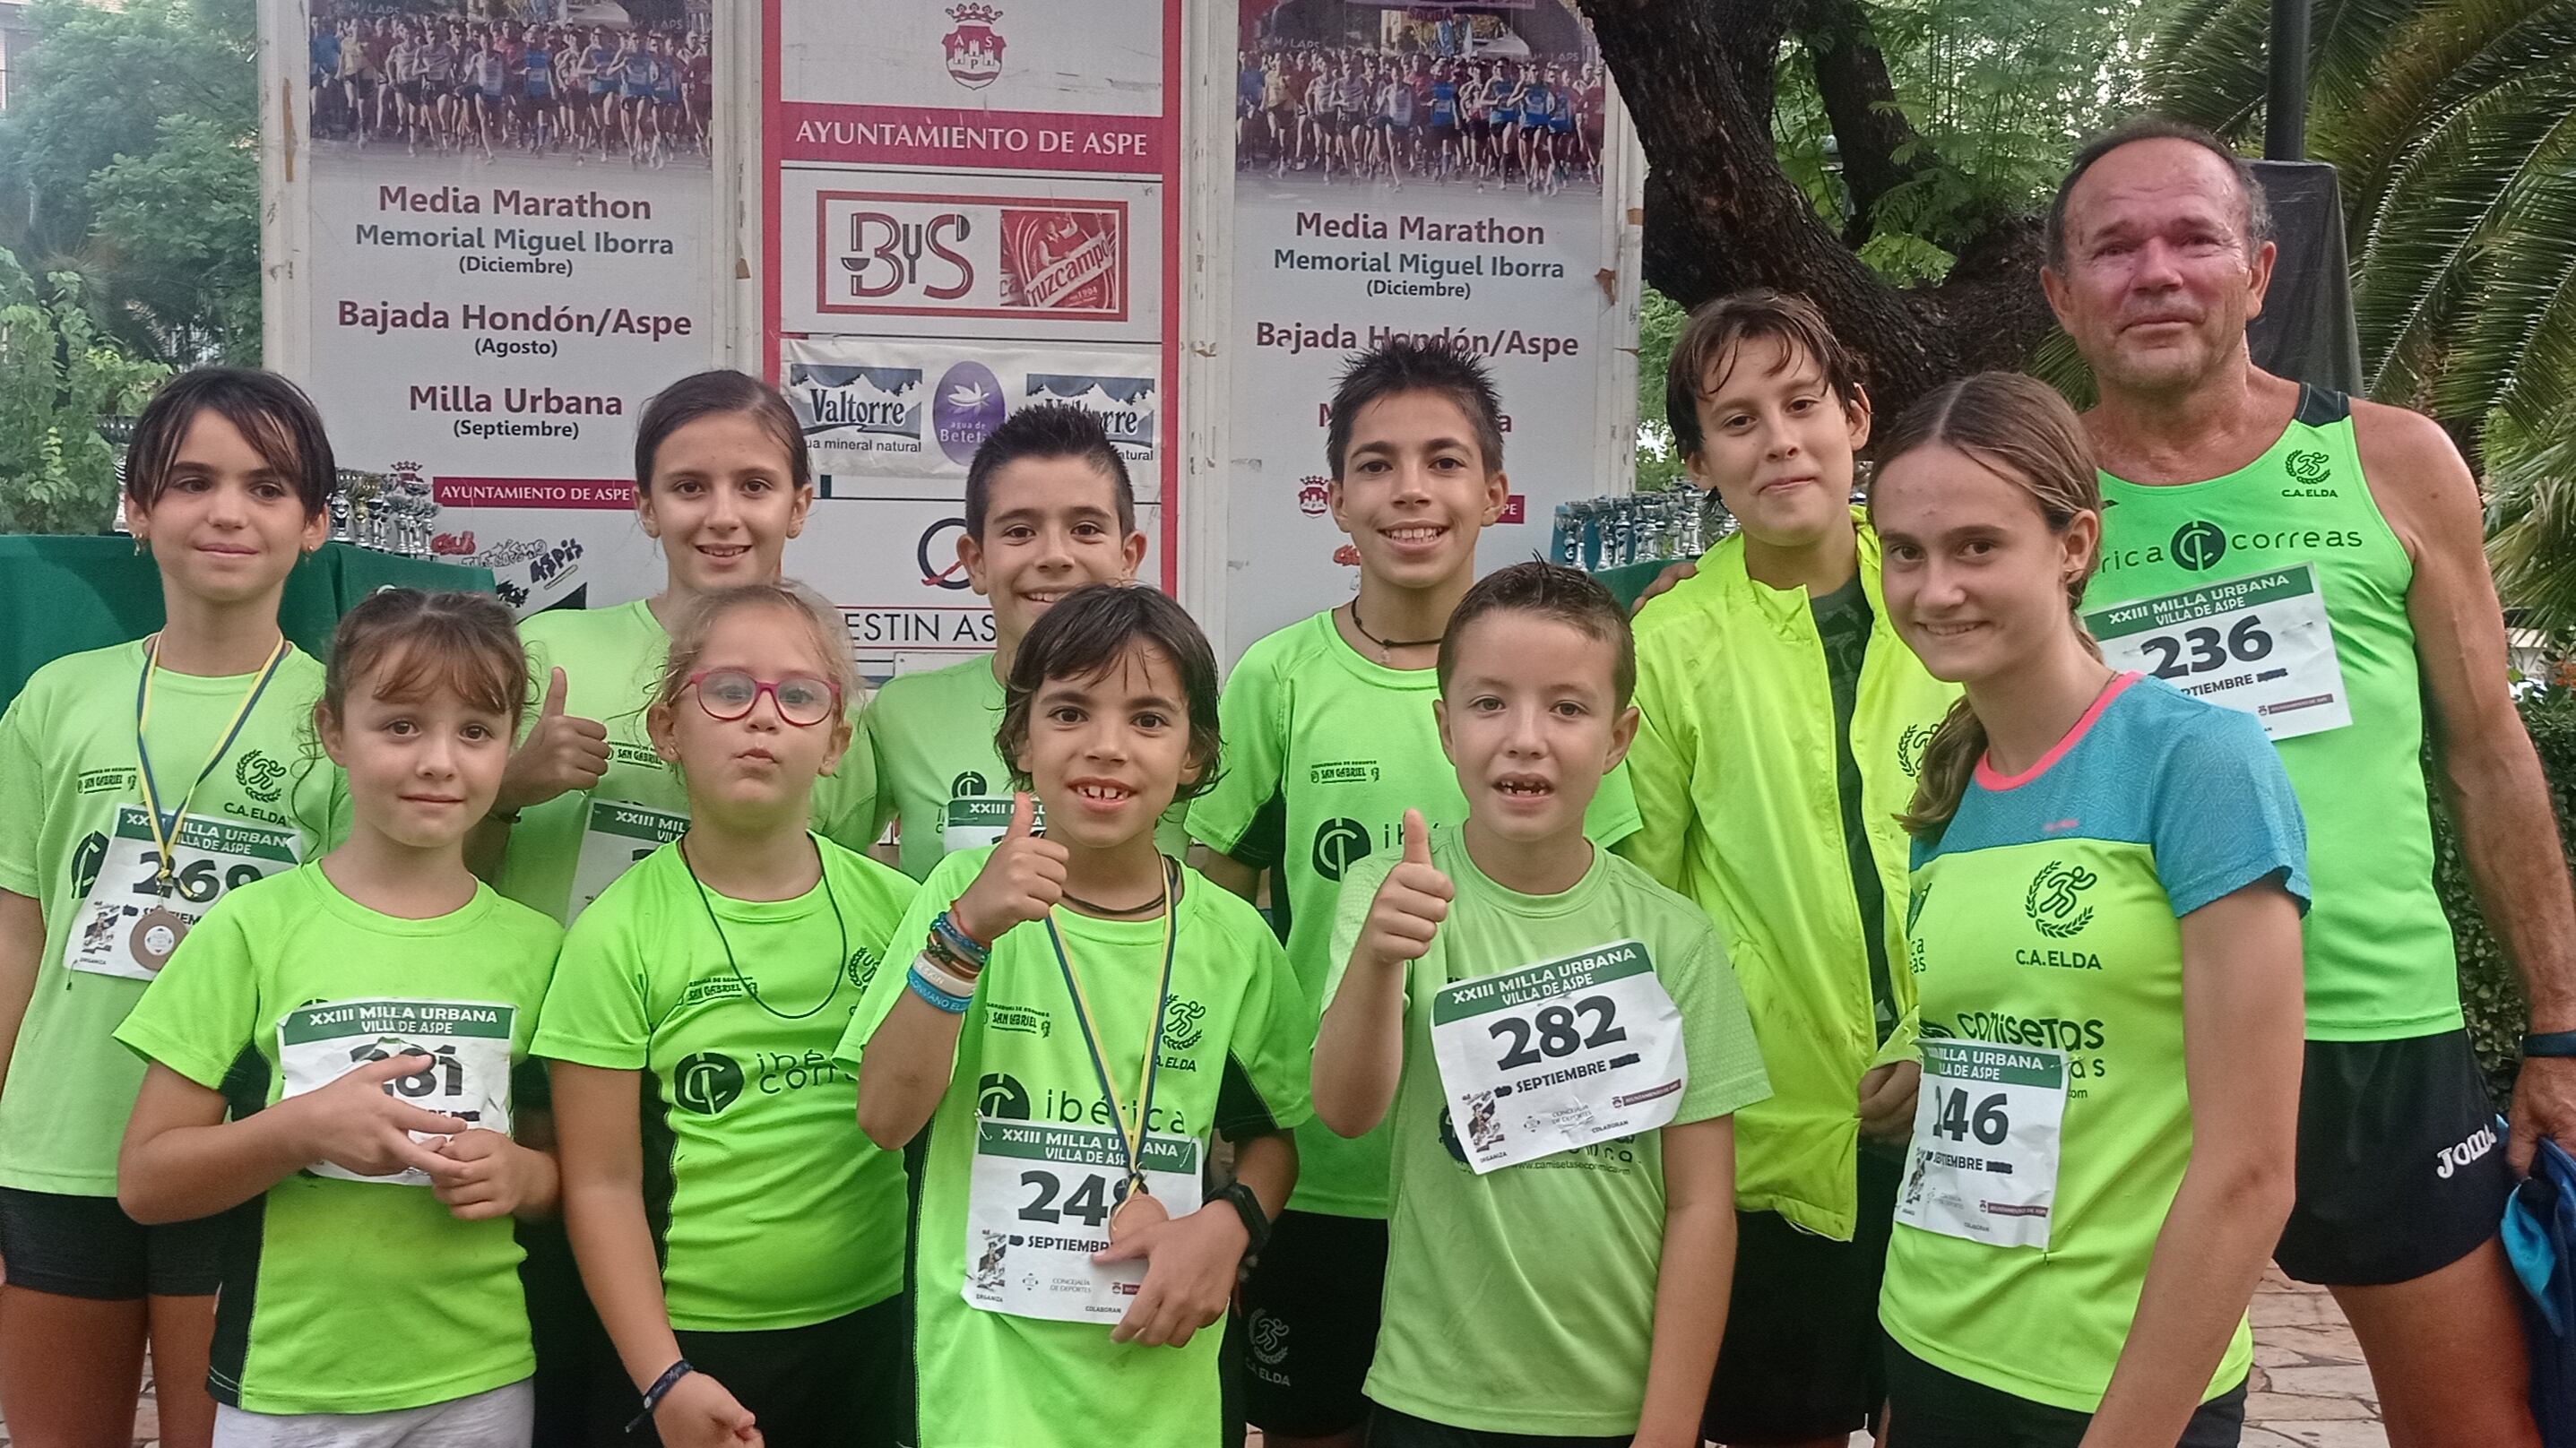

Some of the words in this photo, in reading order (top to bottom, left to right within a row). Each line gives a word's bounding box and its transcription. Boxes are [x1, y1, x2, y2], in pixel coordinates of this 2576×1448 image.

[953, 35, 964, 47] A
[985, 36, 993, 47] S
[795, 121, 1029, 152] AYUNTAMIENTO
[1038, 130, 1075, 153] DE
[1082, 133, 1147, 156] ASPE
[379, 185, 480, 214] Media
[493, 189, 652, 220] Marathon
[356, 224, 485, 248] Memorial
[494, 228, 586, 256] Miguel
[594, 231, 674, 254] Iborra
[1296, 211, 1387, 239] Media
[1399, 216, 1544, 245] Marathon
[459, 255, 573, 278] (Diciembre)
[1274, 249, 1391, 272] Memorial
[1399, 253, 1483, 280] Miguel
[1491, 256, 1564, 278] Iborra
[1367, 280, 1471, 300] (Diciembre)
[338, 301, 449, 335] Bajada
[462, 305, 692, 342] Hondón/Aspe
[474, 338, 558, 358] (Agosto)
[1256, 322, 1357, 354] Bajada
[410, 385, 492, 412] Milla
[505, 388, 623, 415] Urbana
[809, 389, 905, 425] Valtorre
[454, 419, 580, 440] (Septiembre)
[825, 439, 872, 451] mineral
[876, 441, 921, 452] natural
[1120, 450, 1154, 461] atural
[440, 486, 566, 501] AYUNTAMIENTO
[570, 487, 591, 501] DE
[594, 487, 630, 501] ASPE
[2101, 545, 2165, 573] rica
[2231, 530, 2363, 550] correas
[2108, 606, 2148, 625] XXIII
[2152, 592, 2207, 615] MILLA
[2211, 574, 2290, 601] URBANA
[2155, 611, 2193, 626] VILLA
[2194, 606, 2212, 618] DE
[2214, 597, 2245, 615] ASPE
[2140, 615, 2273, 679] 236
[2181, 673, 2253, 696] PTIEMBRE
[615, 810, 654, 827] XXIII
[658, 818, 686, 832] MIL
[969, 803, 1006, 814] XXIII
[179, 833, 200, 848] ILLA
[205, 839, 220, 851] DE
[222, 841, 252, 856] ASPE
[182, 819, 220, 838] ILLA
[225, 829, 289, 848] URBAN
[657, 830, 684, 842] VIL
[1452, 986, 1495, 1004] XXIII
[1500, 970, 1555, 993] MILLA
[1558, 947, 1637, 978] URBANA
[1502, 989, 1541, 1006] VILLA
[1543, 983, 1560, 997] DE
[1561, 973, 1594, 993] ASPE
[309, 1008, 354, 1026] XXIII
[359, 1005, 415, 1020] MILLA
[420, 1007, 497, 1023] URBANA
[398, 1021, 417, 1033] DE
[419, 1021, 453, 1035] ASPE
[1488, 995, 1628, 1071] 282
[1954, 1064, 1968, 1076] DE
[1971, 1066, 2001, 1081] ASPE
[1973, 1051, 2044, 1070] URBANA
[1516, 1060, 1607, 1093] SEPTIEMBRE
[1046, 1089, 1185, 1134] ibéica
[1002, 1128, 1041, 1144] XXIII
[1045, 1132, 1102, 1150] MILLA
[1108, 1138, 1179, 1157] UANA
[1045, 1147, 1081, 1161] VILLA
[1085, 1150, 1102, 1163] DE
[1027, 1235, 1114, 1254] SEPTIEMBR
